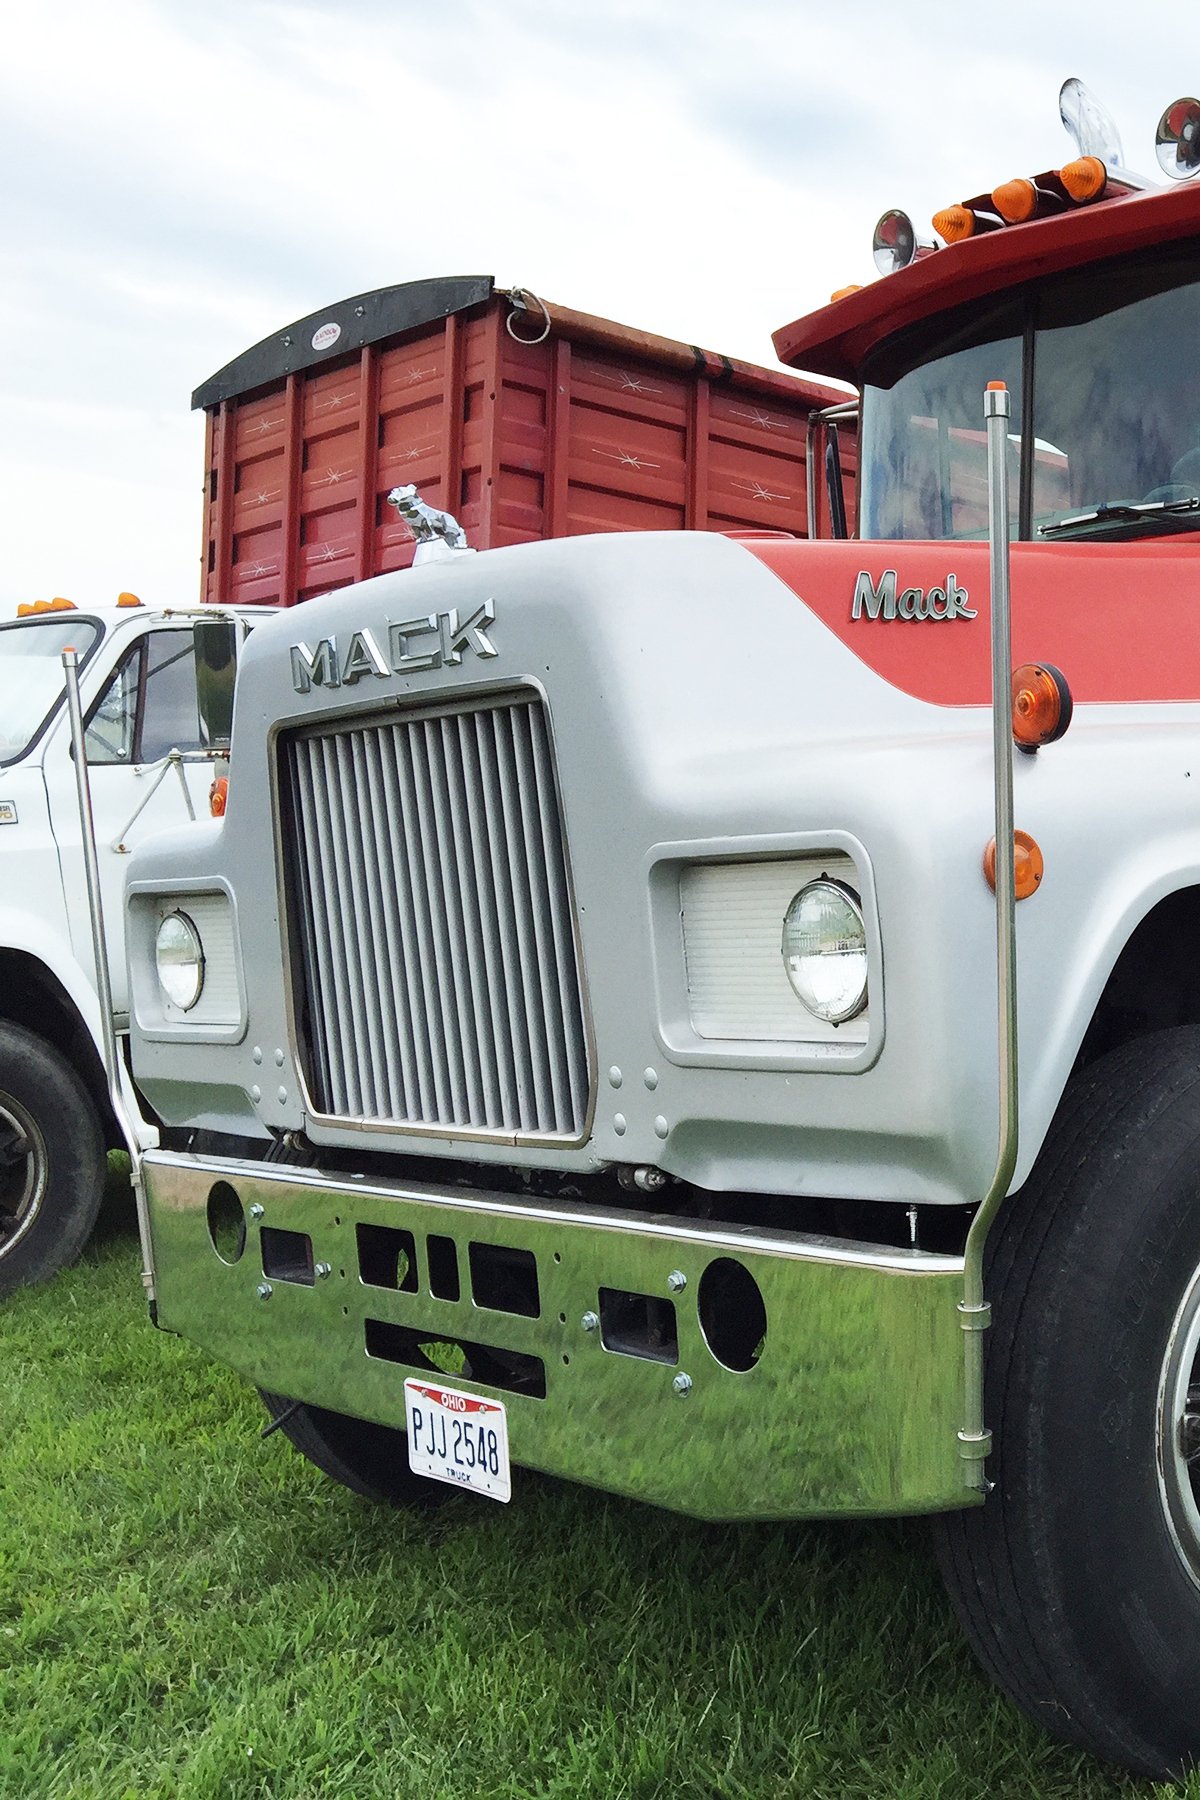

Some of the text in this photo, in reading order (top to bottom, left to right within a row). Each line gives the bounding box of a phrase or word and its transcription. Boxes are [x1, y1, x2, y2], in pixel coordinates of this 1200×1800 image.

[851, 569, 978, 622] Mack
[289, 597, 499, 694] MACK
[440, 1393, 467, 1412] OHIO
[446, 1467, 472, 1484] TRUCK
